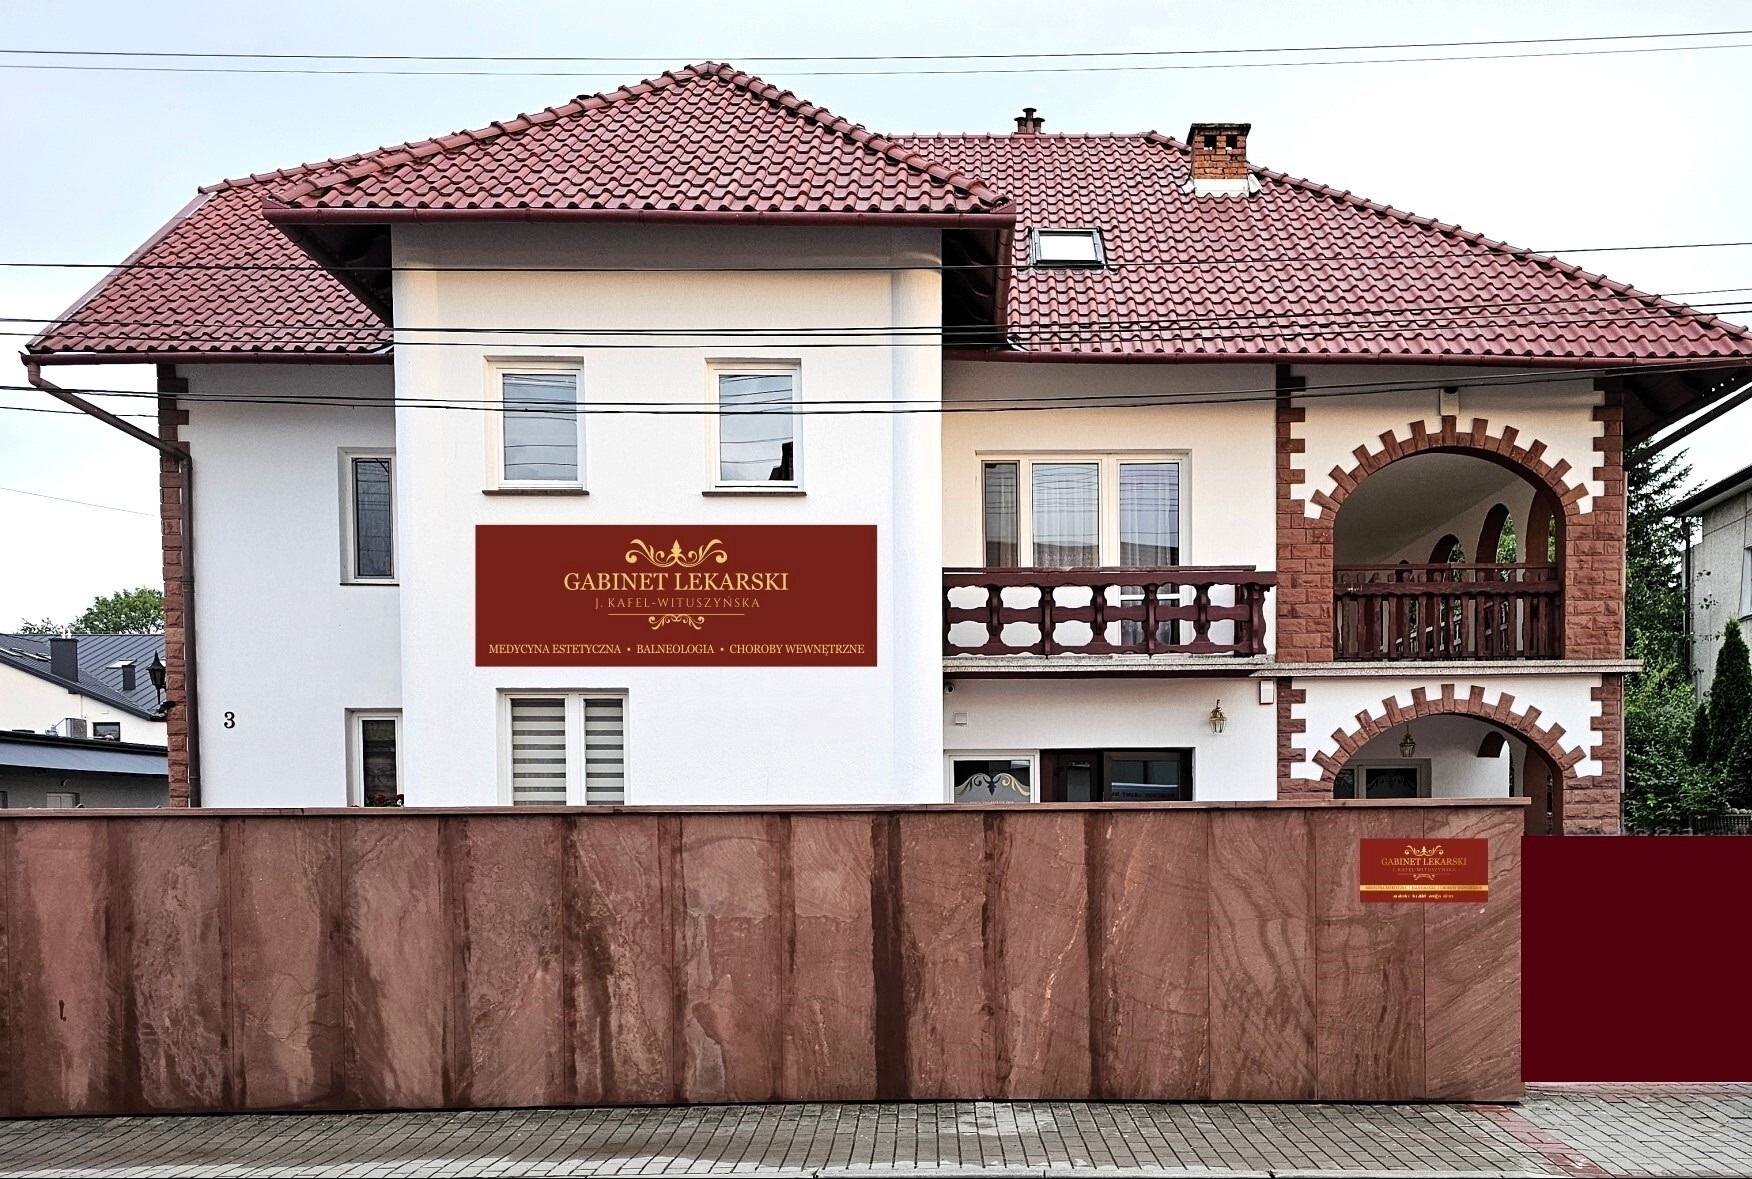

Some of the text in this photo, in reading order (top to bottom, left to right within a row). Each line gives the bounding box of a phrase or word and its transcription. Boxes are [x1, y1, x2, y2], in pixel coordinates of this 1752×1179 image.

[563, 572, 789, 591] GABINET LEKARSKI
[595, 596, 761, 610] J. KAFEL-WITUSZYŃSKA
[488, 643, 865, 656] MEDYCYNA ESTETYCZNA BALNEOLOGIA CHOROBY WEWNĘTRZNE
[223, 711, 236, 729] 3
[1381, 857, 1467, 866] GABINET LEKARSKI
